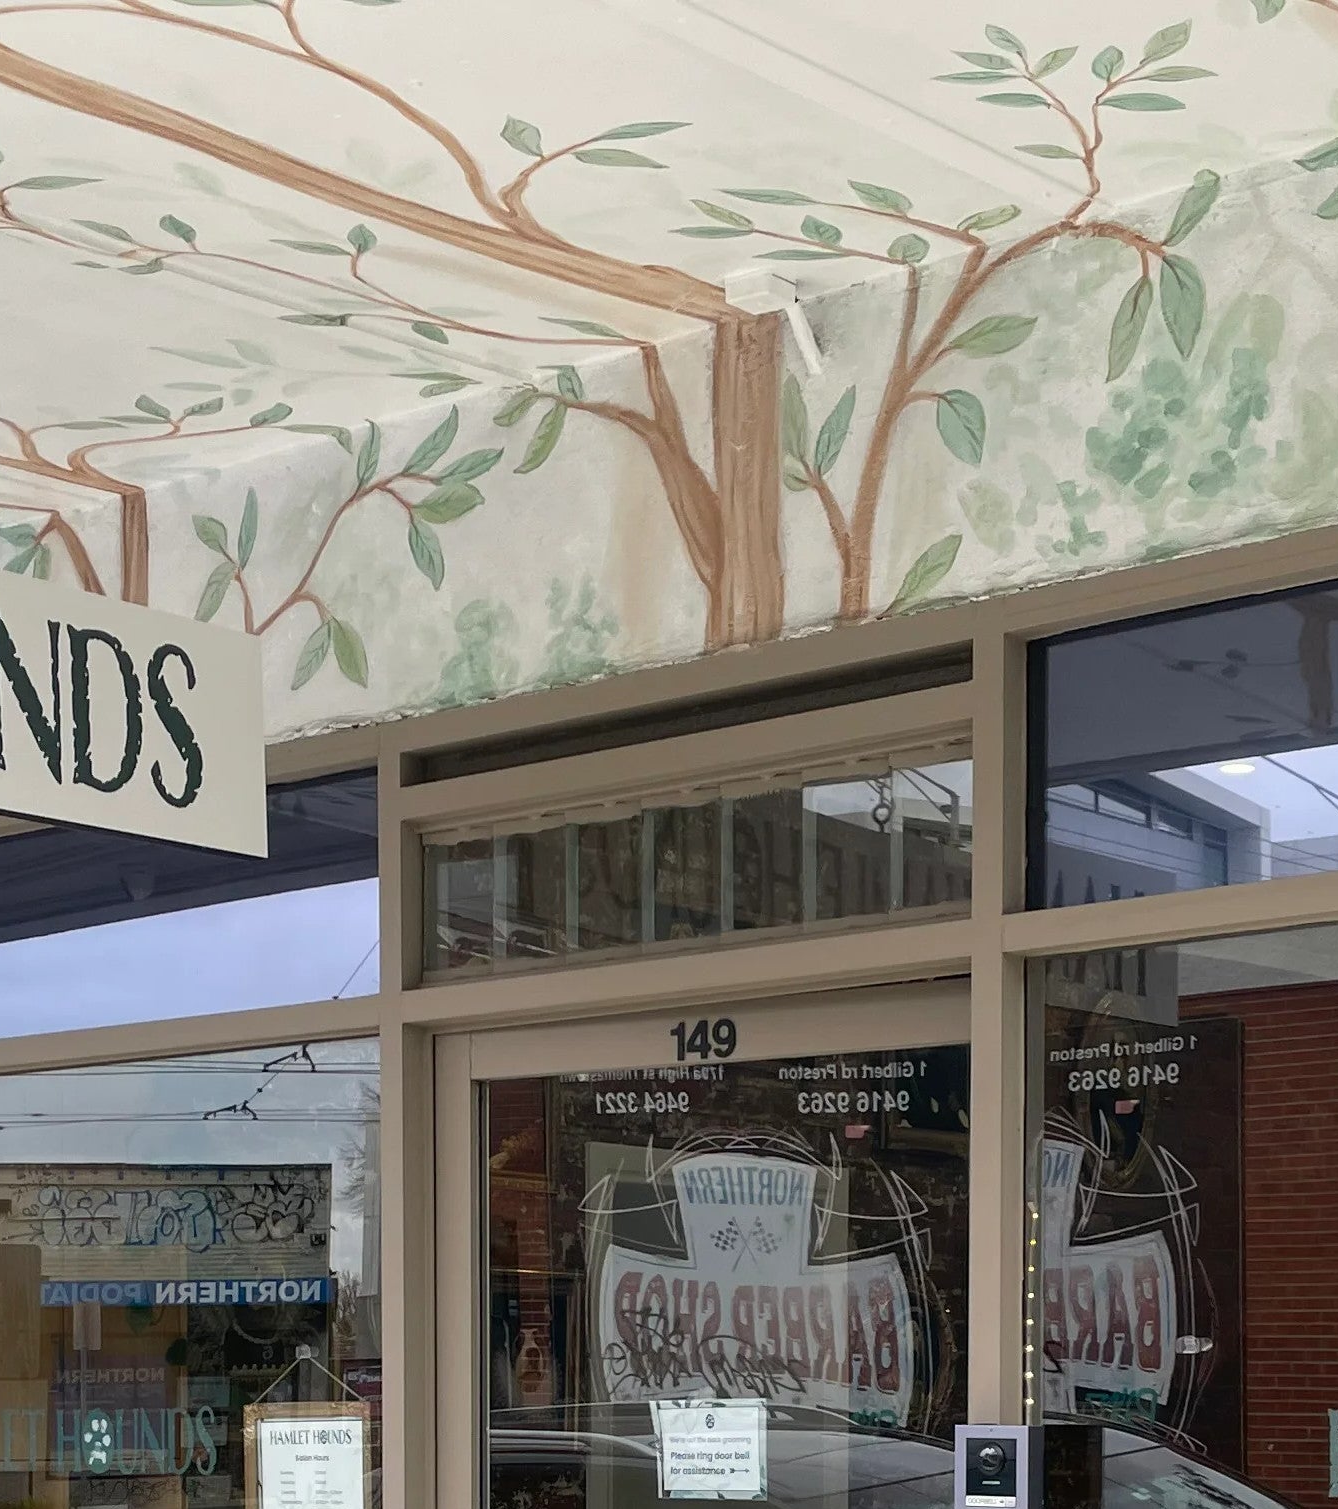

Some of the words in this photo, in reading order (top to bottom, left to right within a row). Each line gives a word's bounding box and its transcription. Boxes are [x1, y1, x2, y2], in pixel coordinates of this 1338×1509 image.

[669, 1019, 738, 1061] 149
[55, 1404, 217, 1477] HOUNDS
[269, 1430, 310, 1446] HAMLET
[313, 1428, 352, 1446] HOUNDS
[670, 1451, 696, 1460] Please
[696, 1450, 713, 1462] ring
[714, 1450, 733, 1460] door
[734, 1450, 750, 1460] bell
[670, 1466, 682, 1475] for
[682, 1466, 725, 1475] assistance
